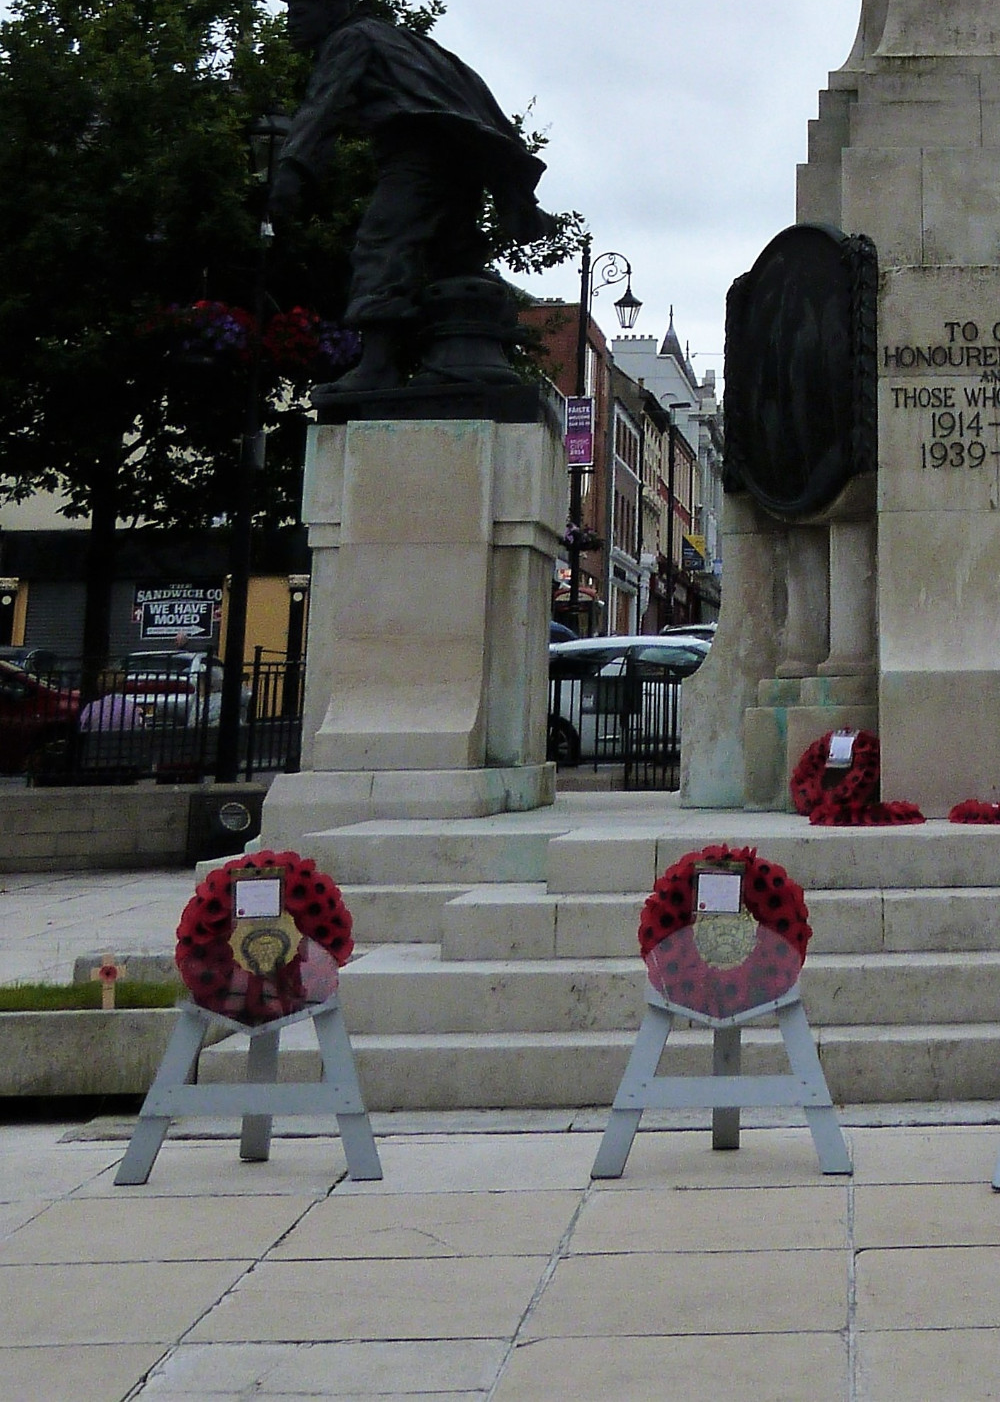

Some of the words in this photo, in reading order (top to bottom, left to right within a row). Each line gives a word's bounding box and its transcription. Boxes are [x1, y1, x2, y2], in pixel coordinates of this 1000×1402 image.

[944, 321, 979, 342] TO
[891, 387, 956, 408] THOSE
[136, 589, 204, 602] SANDWICH
[206, 588, 223, 601] CO
[150, 604, 170, 614] WE
[174, 603, 207, 614] HAVE
[154, 614, 200, 625] MOVED
